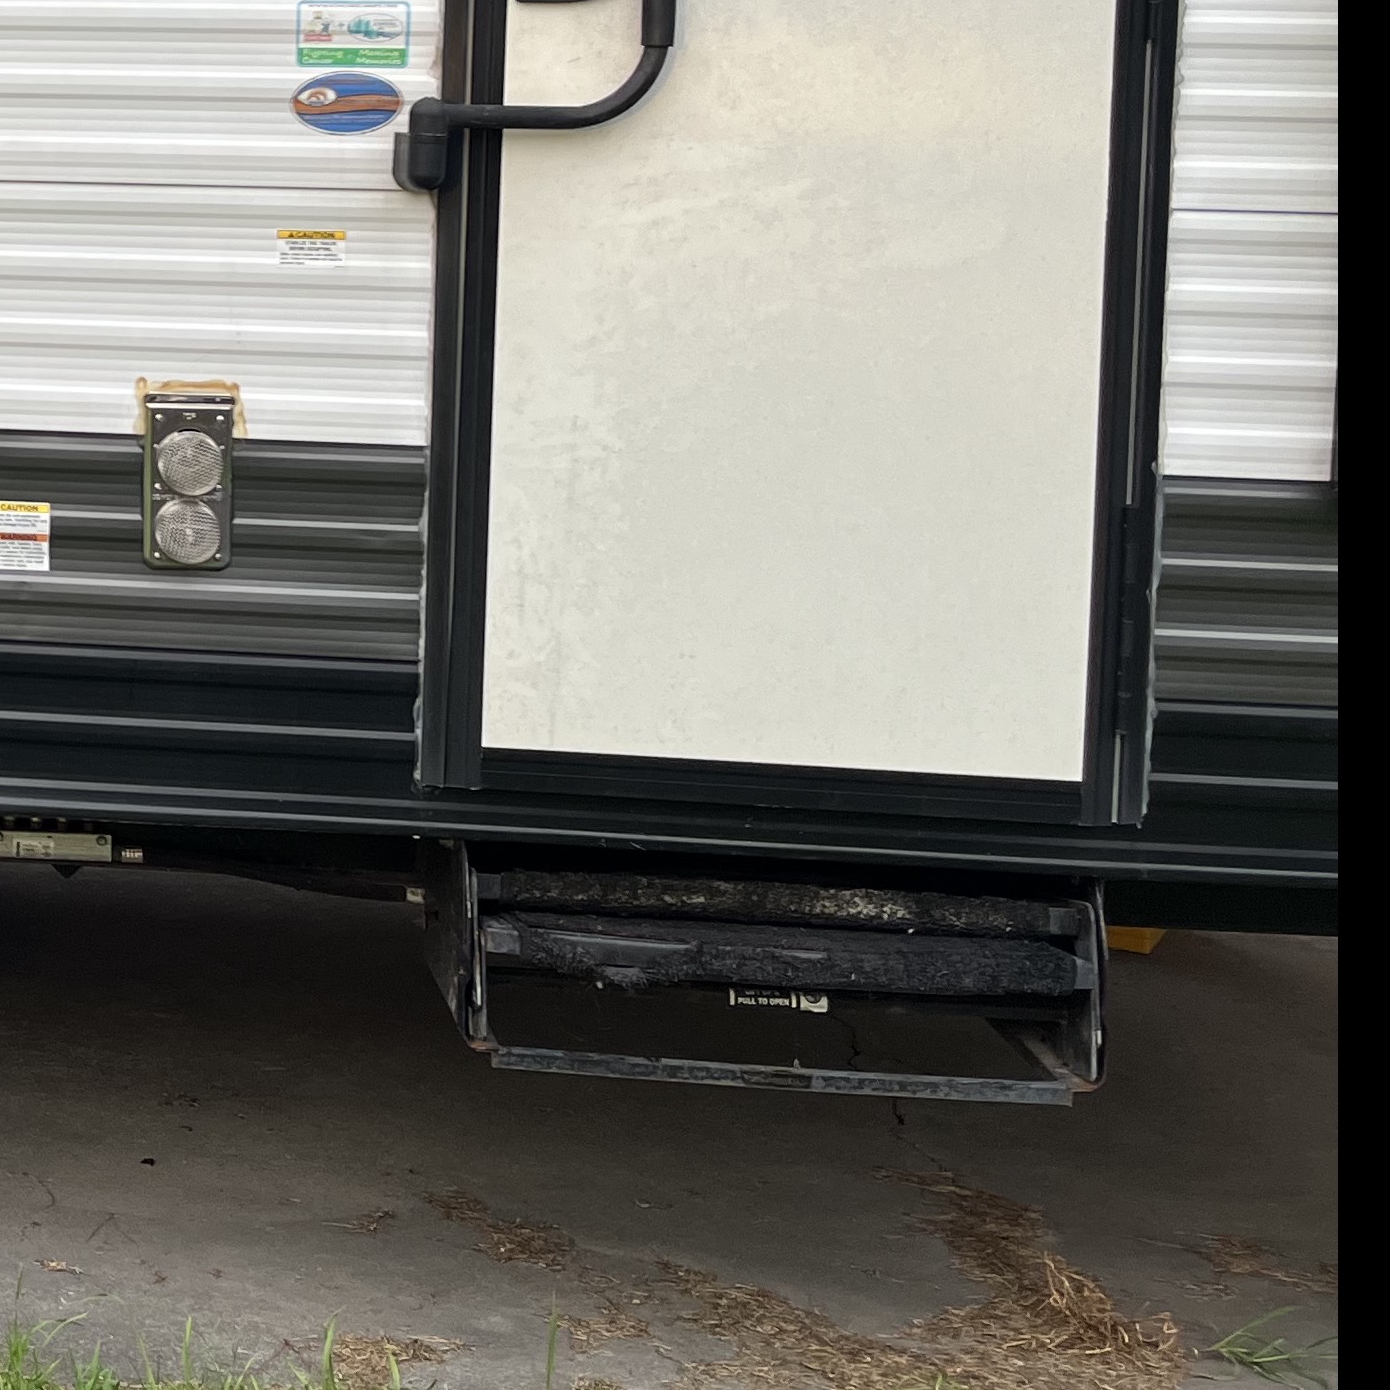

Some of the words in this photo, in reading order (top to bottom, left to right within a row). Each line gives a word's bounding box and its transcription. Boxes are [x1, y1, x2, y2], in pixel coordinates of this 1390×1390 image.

[0, 504, 39, 512] CAUTION
[737, 997, 756, 1005] PULL
[758, 997, 768, 1005] TO
[769, 998, 790, 1007] OPEN
